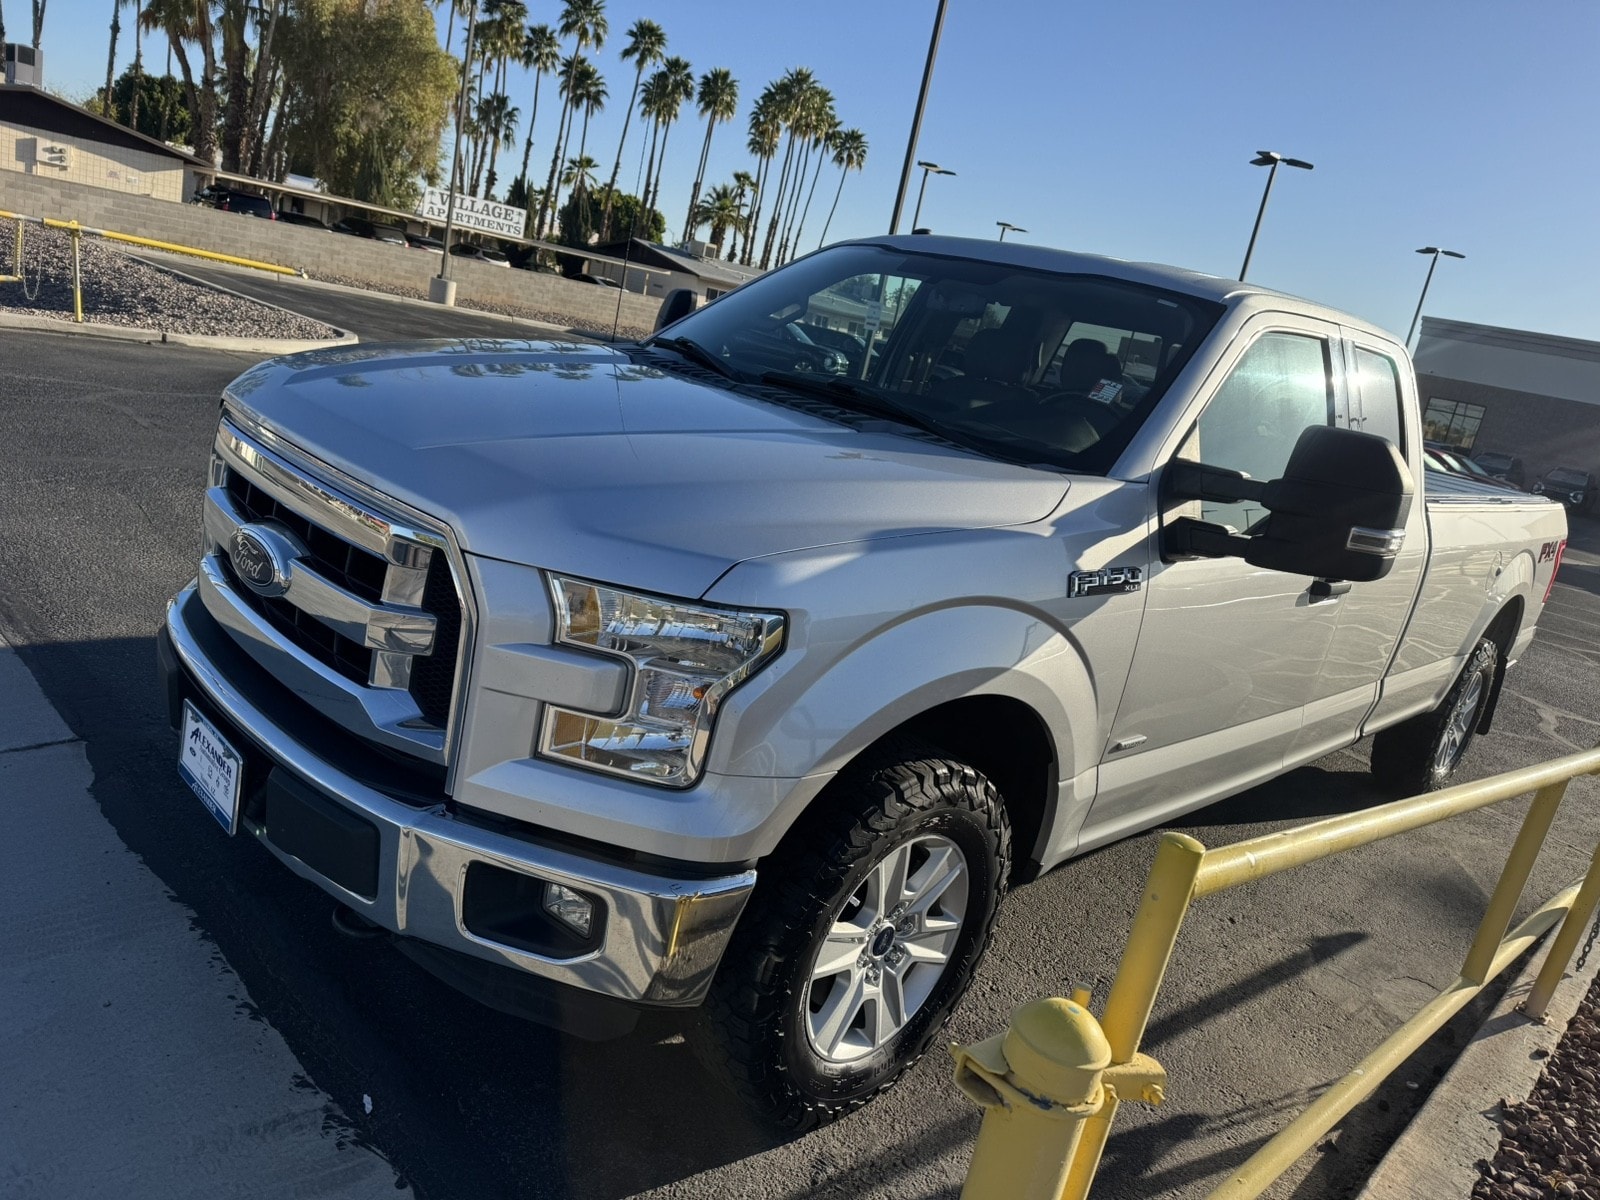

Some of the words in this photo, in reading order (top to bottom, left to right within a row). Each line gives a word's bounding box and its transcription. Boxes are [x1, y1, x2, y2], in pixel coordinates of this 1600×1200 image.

[426, 205, 521, 236] APRTMENTS
[234, 540, 264, 579] Ford
[1124, 584, 1139, 592] XLT
[190, 727, 232, 779] ALEXANDER
